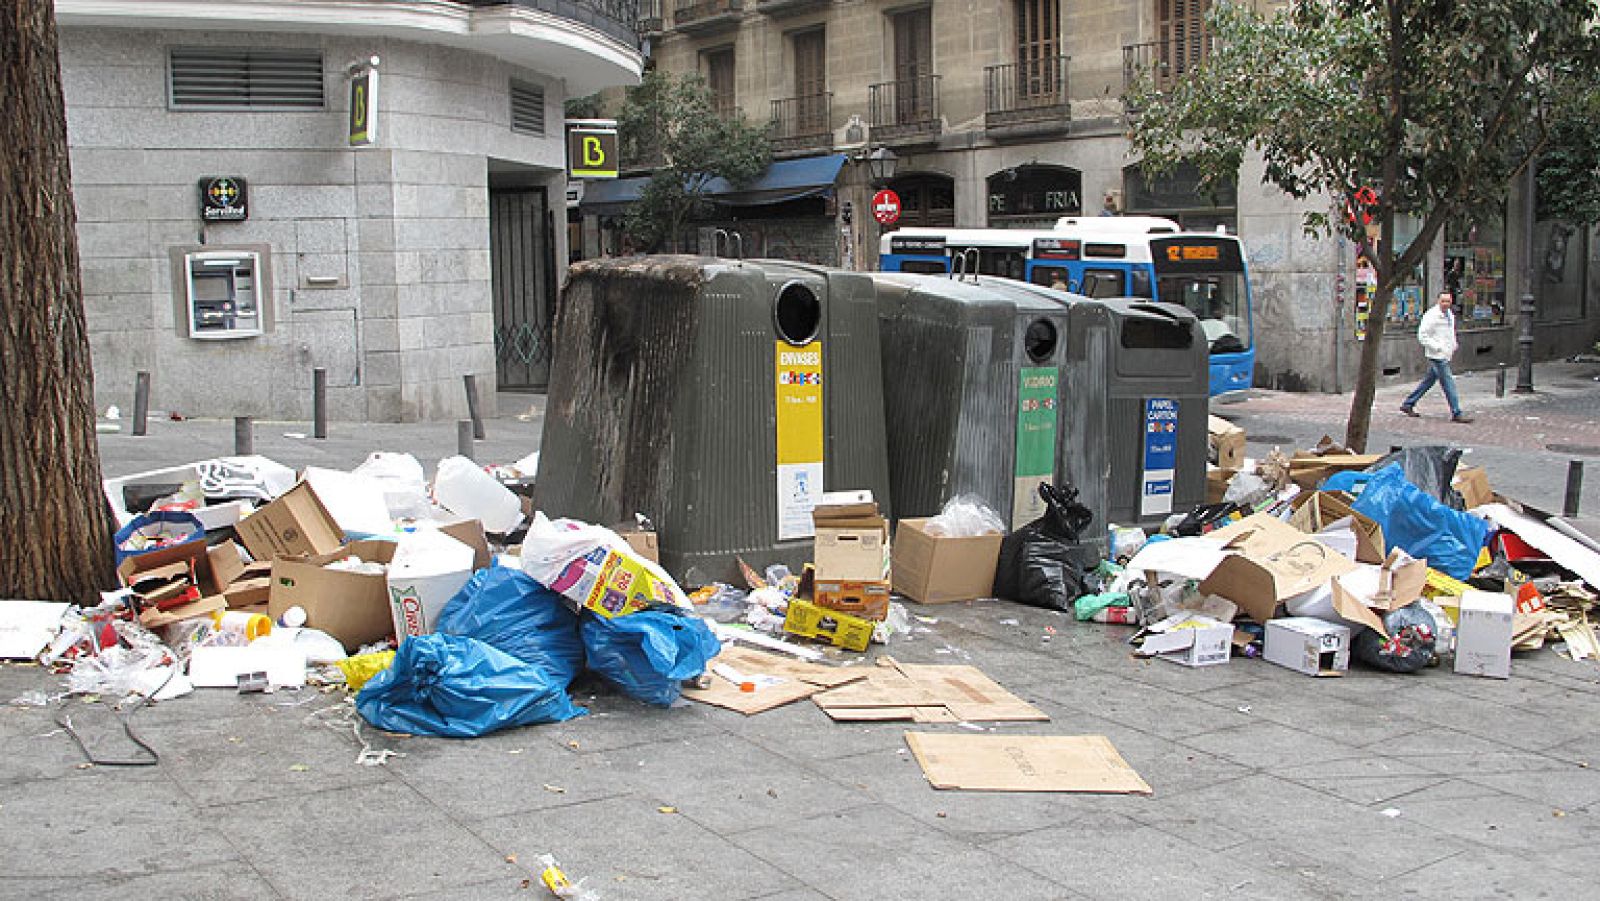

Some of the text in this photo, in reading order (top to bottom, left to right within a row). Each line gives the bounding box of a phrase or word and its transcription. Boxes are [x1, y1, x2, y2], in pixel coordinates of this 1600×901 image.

[354, 86, 366, 128] B
[583, 136, 606, 167] B
[780, 351, 820, 366] ENVASES
